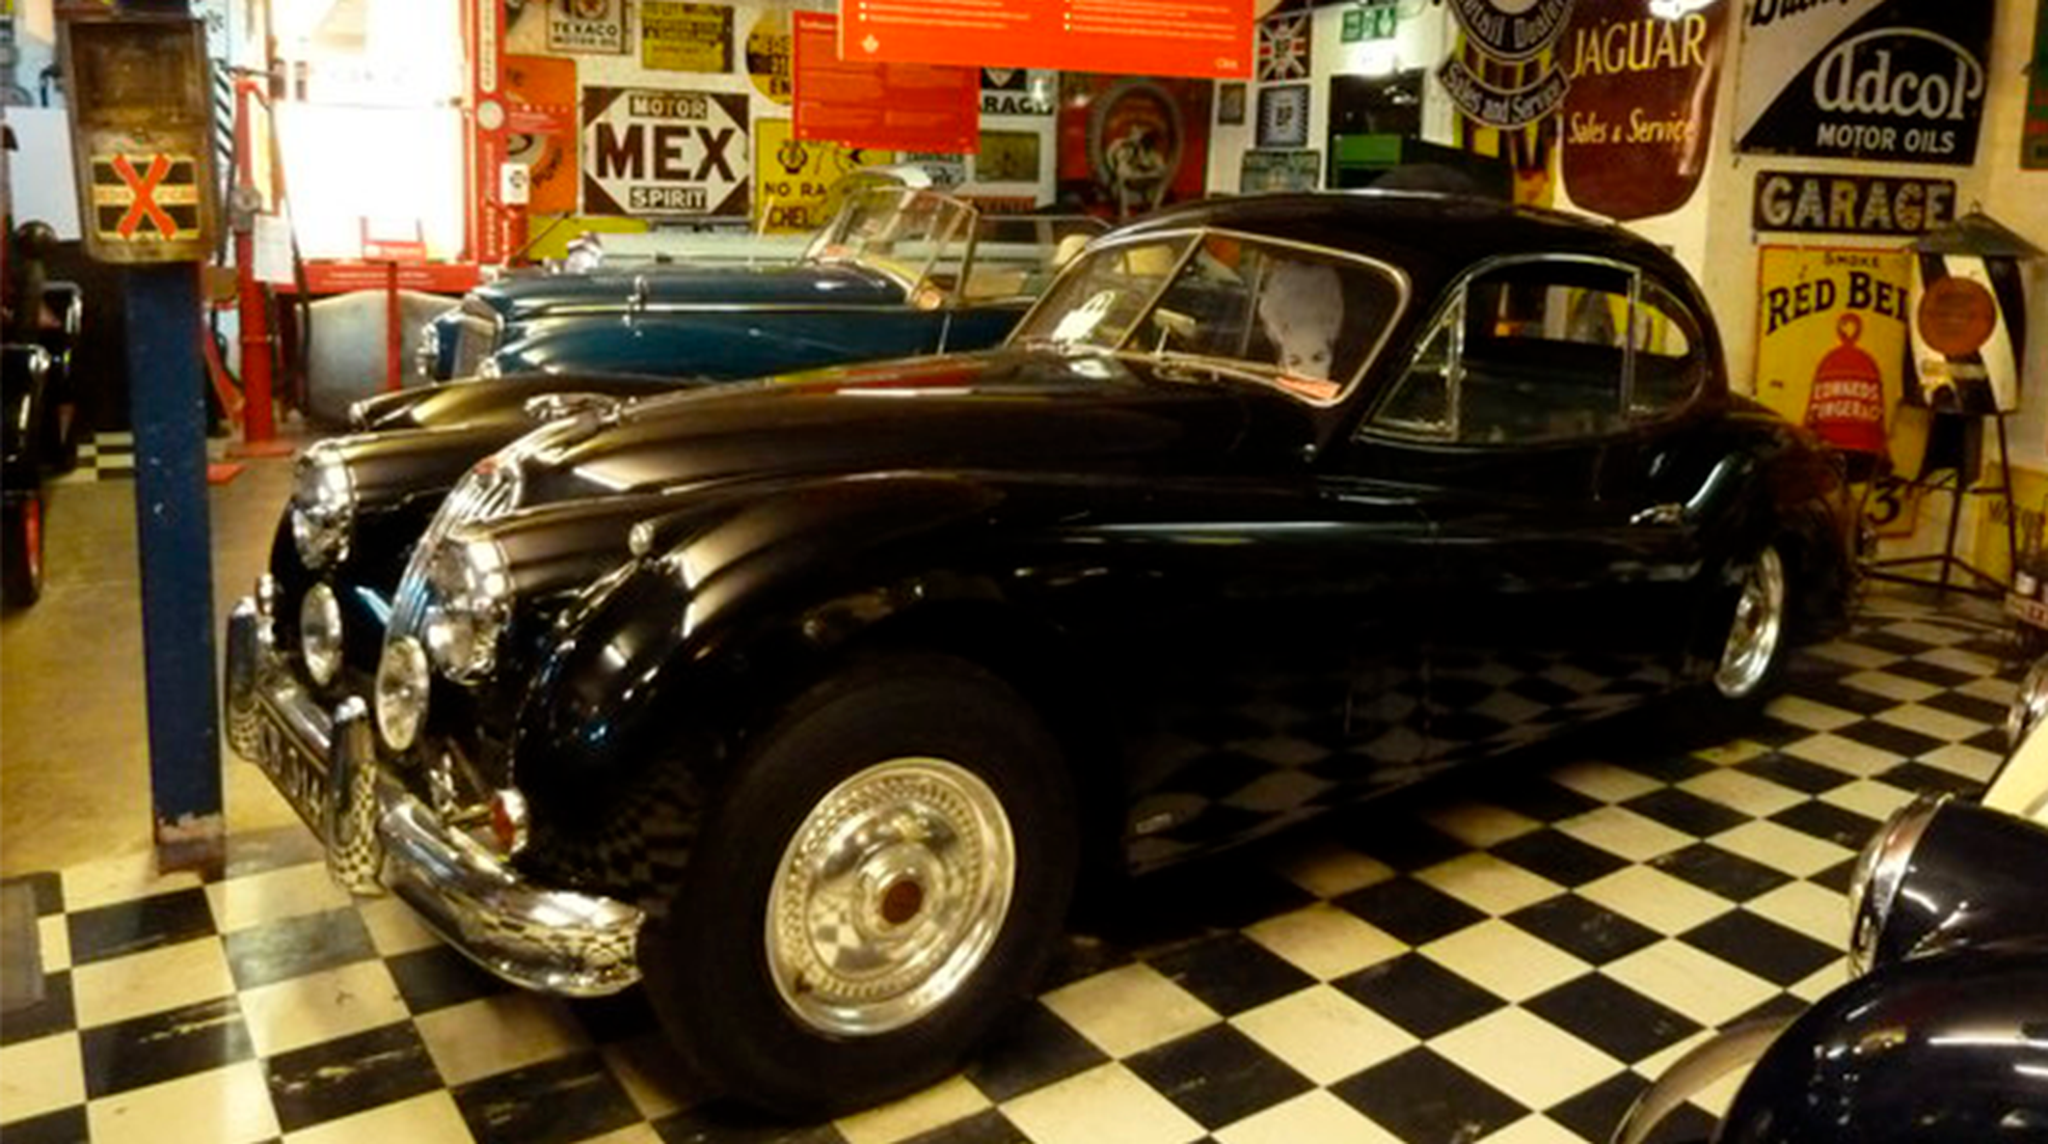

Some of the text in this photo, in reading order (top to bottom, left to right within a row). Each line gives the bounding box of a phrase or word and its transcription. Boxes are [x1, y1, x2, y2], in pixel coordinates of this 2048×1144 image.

[552, 36, 618, 47] MOTOR OIL
[553, 22, 618, 37] TEXACO
[1569, 12, 1707, 80] JAGUAR
[632, 96, 706, 117] MOTOR
[1448, 61, 1483, 114] Sales
[1482, 98, 1510, 124] and
[1567, 111, 1607, 143] Sales
[1626, 107, 1698, 143] Service
[1815, 121, 1956, 154] MOTOR OILS
[596, 121, 736, 183] MEX
[632, 189, 704, 208] SPIRIT
[1760, 176, 1956, 231] GARAGE
[1824, 252, 1879, 268] SMOKE
[1766, 278, 1836, 337] RED
[1866, 477, 1901, 527] 3
